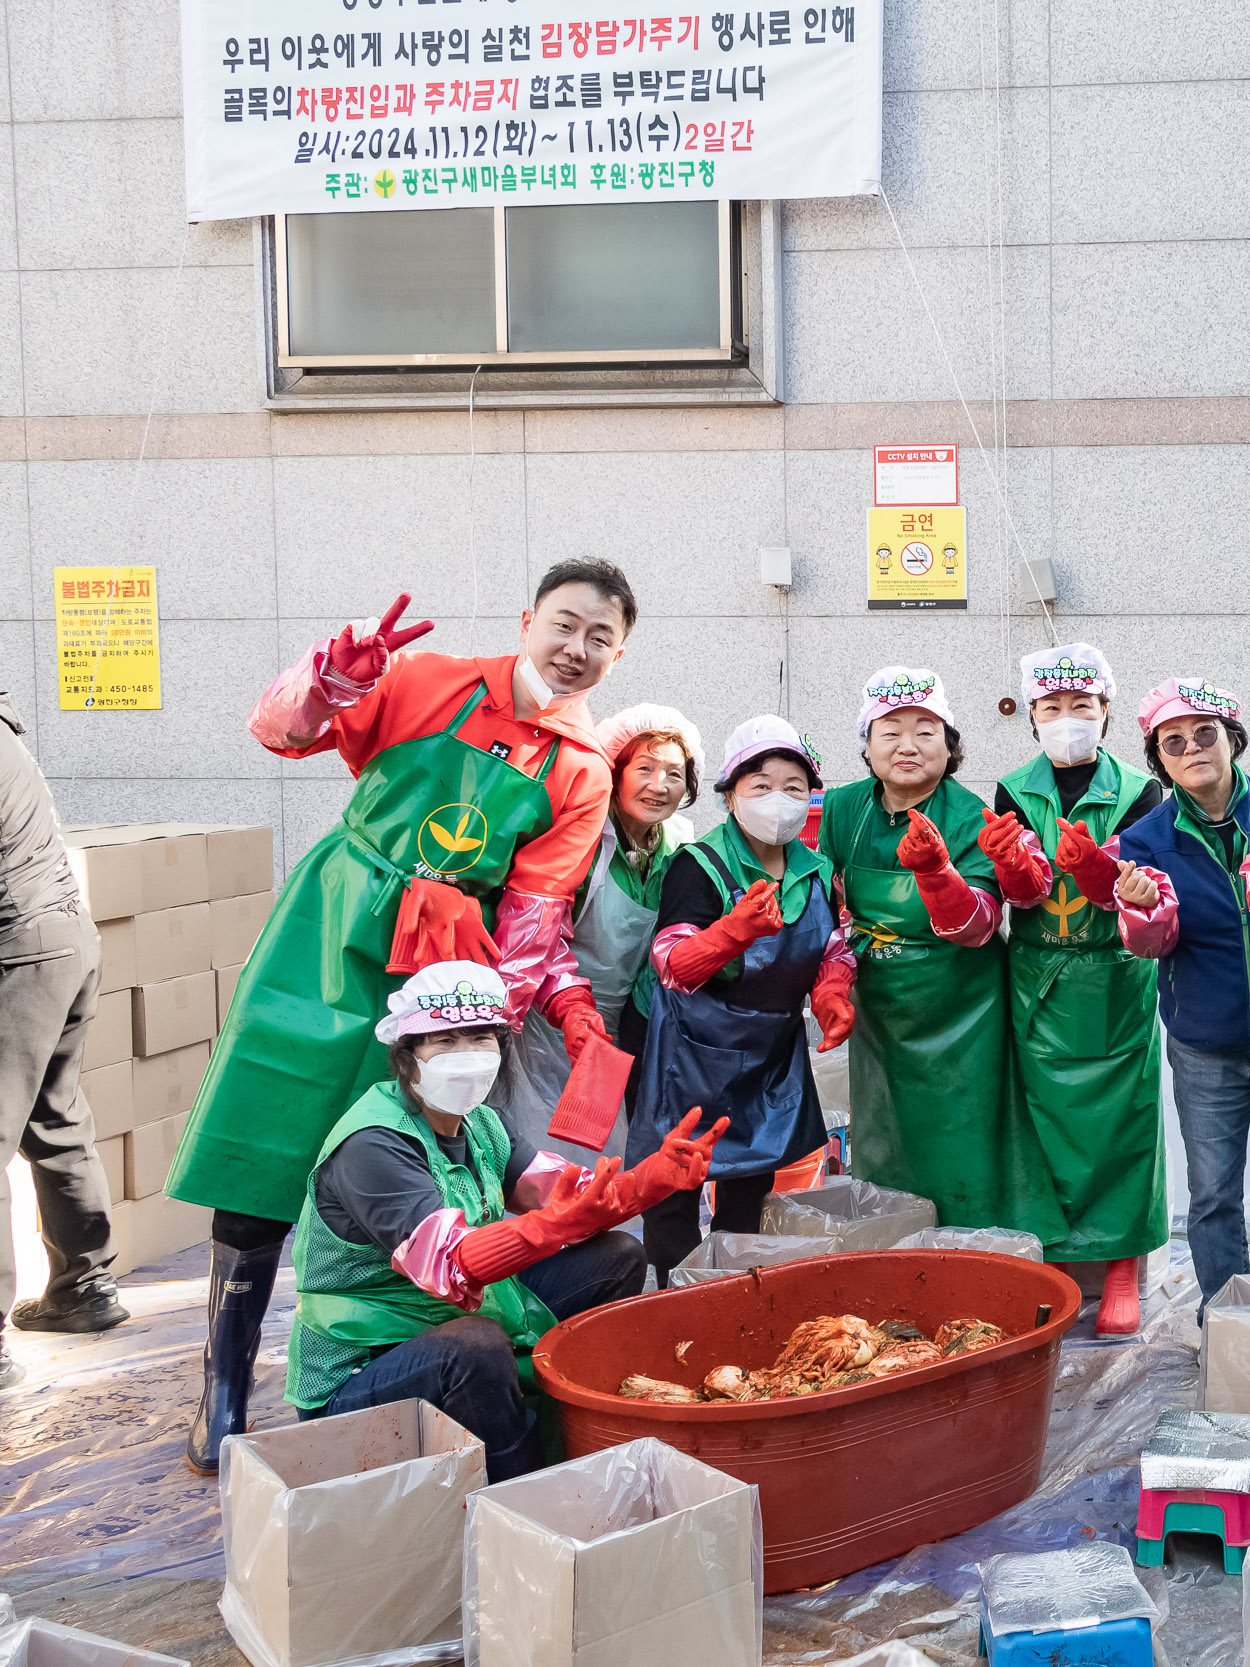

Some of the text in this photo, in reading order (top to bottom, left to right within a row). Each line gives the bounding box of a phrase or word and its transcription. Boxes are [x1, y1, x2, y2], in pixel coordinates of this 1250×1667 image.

[223, 6, 855, 73] 우리 이웃에게 사랑의 실천 김장담가주기 행사로 인해
[424, 78, 519, 114] 주차금지
[530, 73, 602, 109] 협조를
[612, 65, 766, 106] 부탁드립니다
[325, 160, 715, 199] 주관: 광진구새마을부녀회 후원:광진구청
[887, 452, 933, 461] CCTV 설치 안내
[900, 513, 933, 532] 금연
[62, 580, 150, 599] 불법주차금지
[110, 685, 154, 693] 450-1485
